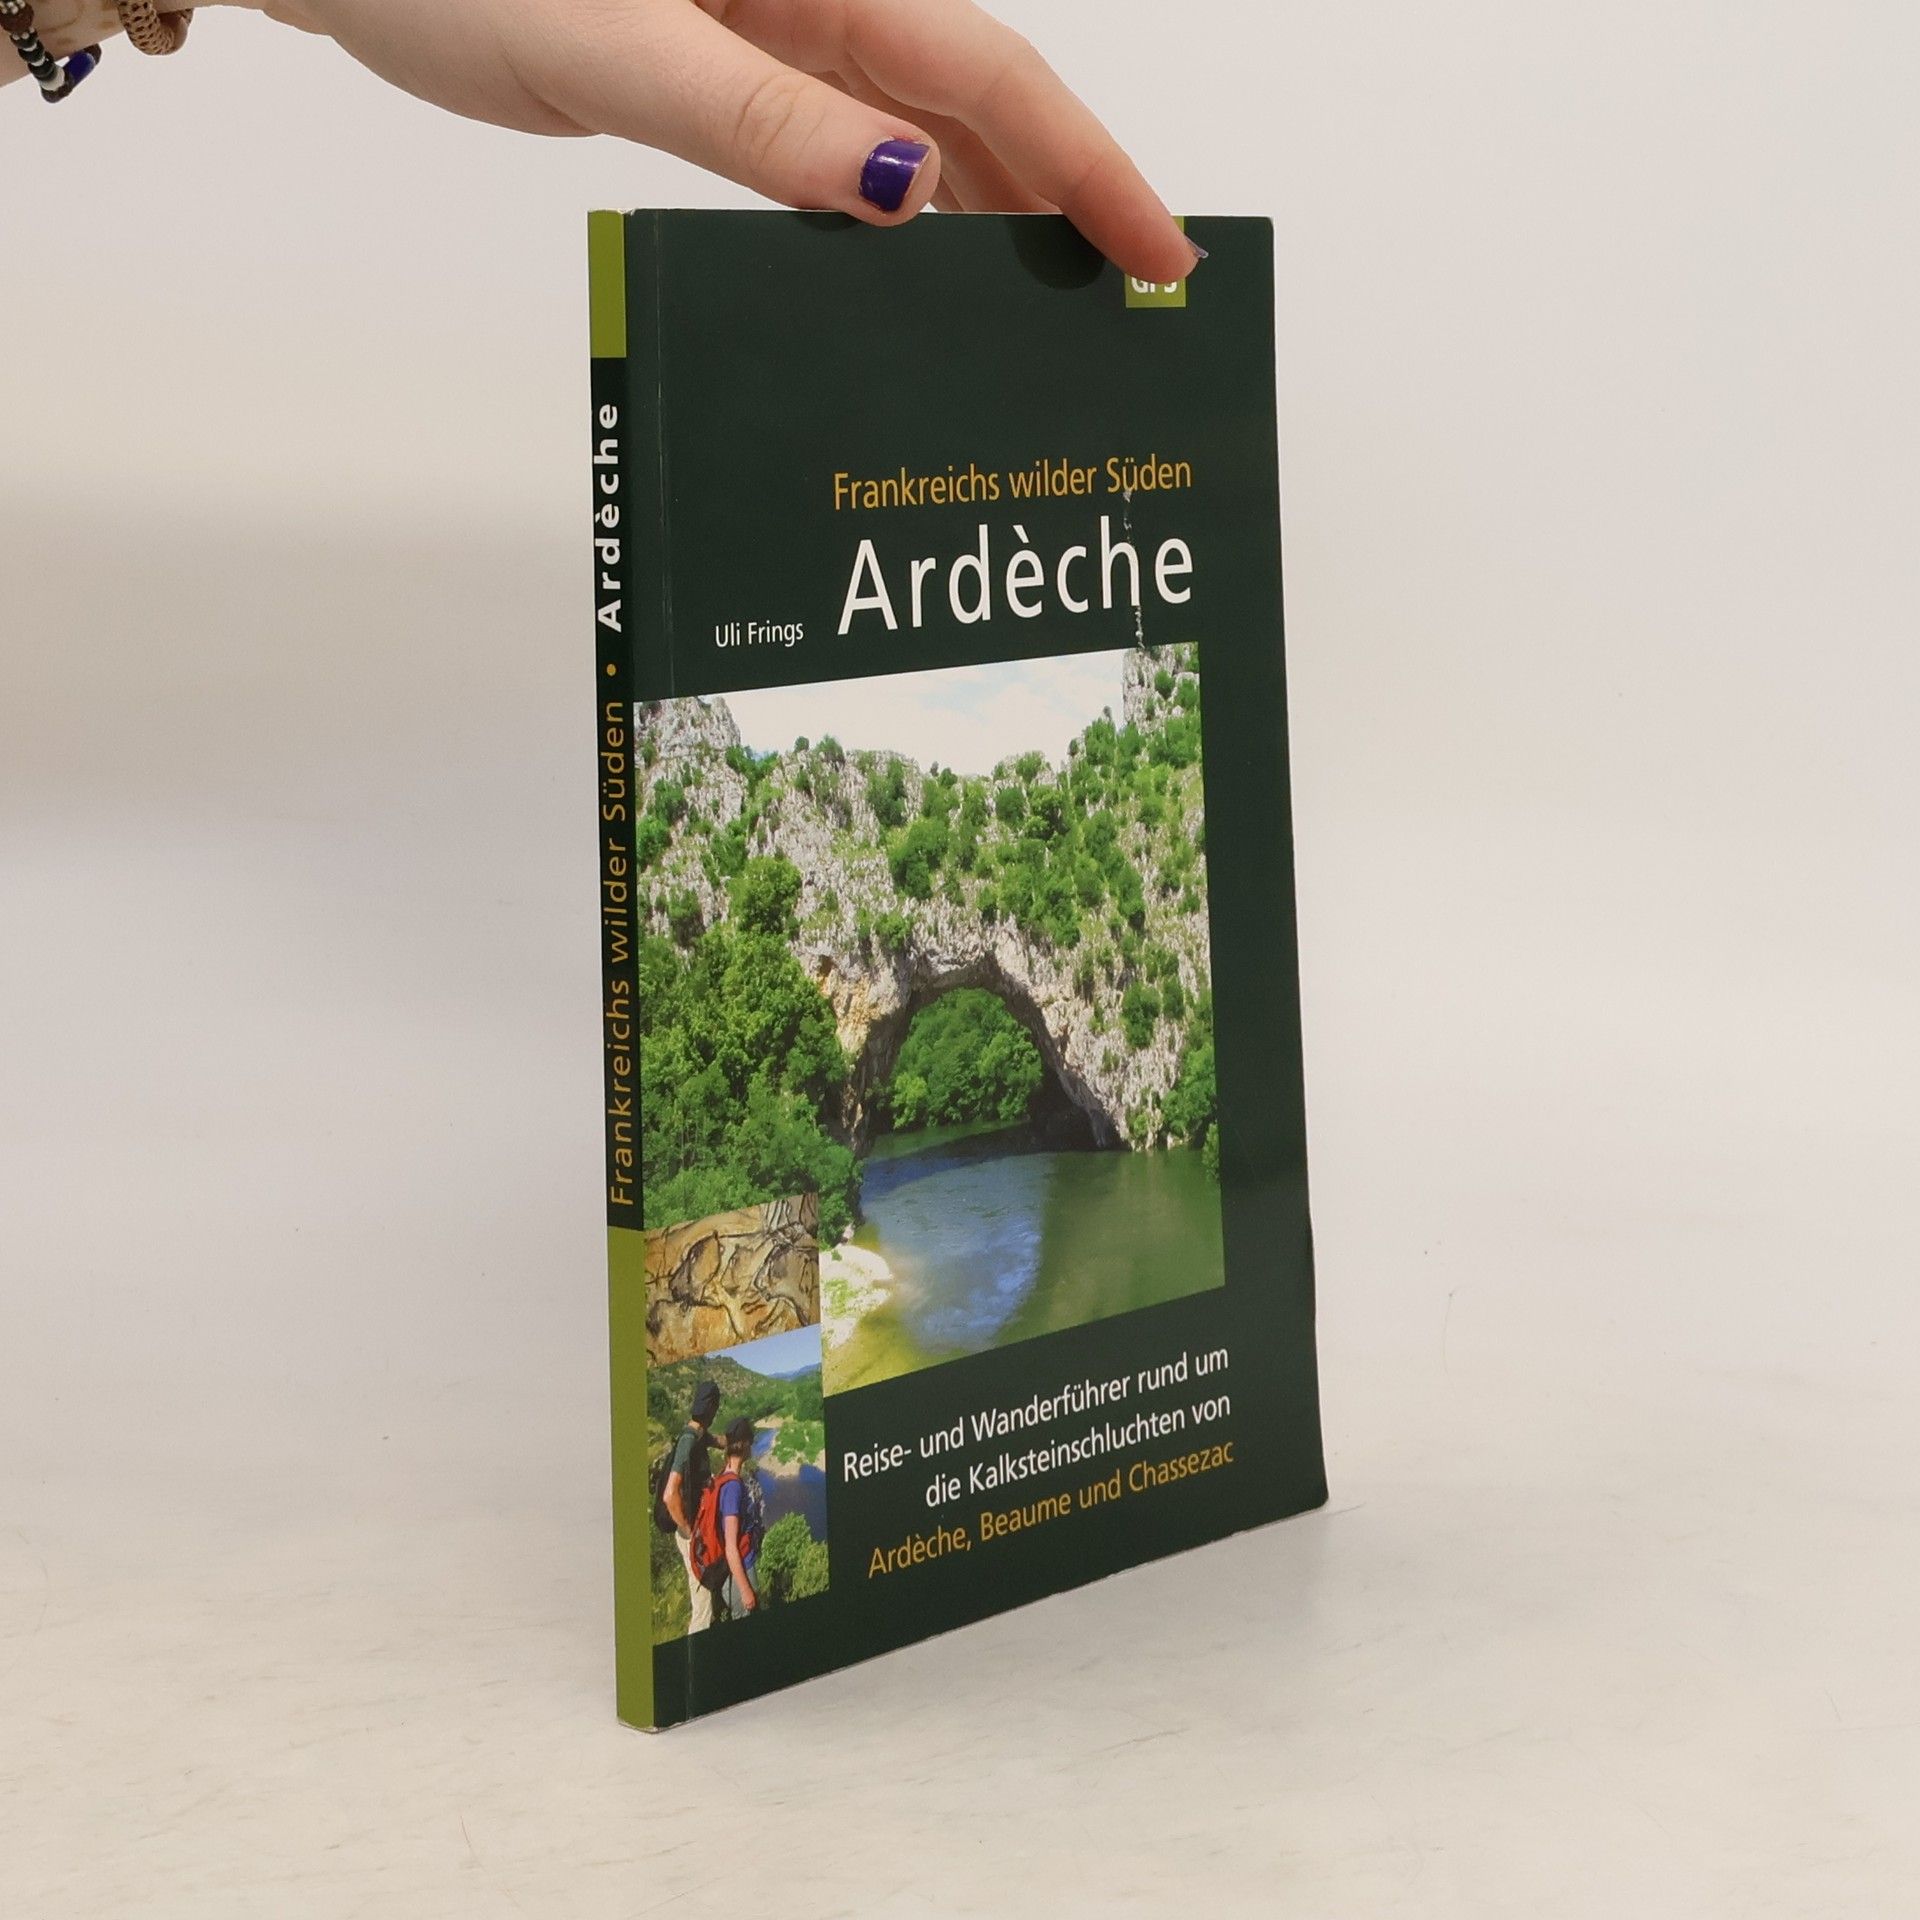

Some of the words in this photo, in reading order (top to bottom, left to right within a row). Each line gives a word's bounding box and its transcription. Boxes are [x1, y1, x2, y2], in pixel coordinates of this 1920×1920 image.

[592, 404, 622, 633] Ardèche
[834, 463, 1000, 511] Frankreichs
[1008, 459, 1098, 498] wilder
[1106, 454, 1192, 493] Süden
[715, 622, 742, 648] Uli
[747, 618, 804, 648] Frings
[837, 515, 1193, 636] Ardèche
[601, 702, 625, 821] Süden
[604, 838, 628, 964] wilder
[606, 979, 633, 1206] Frankreichs
[843, 1443, 912, 1483] Reise-
[919, 1416, 965, 1459] und
[970, 1375, 1131, 1442] Wanderführer
[1137, 1351, 1188, 1394] rund
[1195, 1347, 1229, 1377] um
[925, 1472, 961, 1508] die
[968, 1408, 1186, 1495] Kalksteinschluchten
[1191, 1395, 1231, 1428] von
[868, 1525, 972, 1579] Ardèche,
[980, 1493, 1072, 1543] Beaume
[1079, 1469, 1122, 1509] und
[1128, 1438, 1234, 1493] Chassezac
